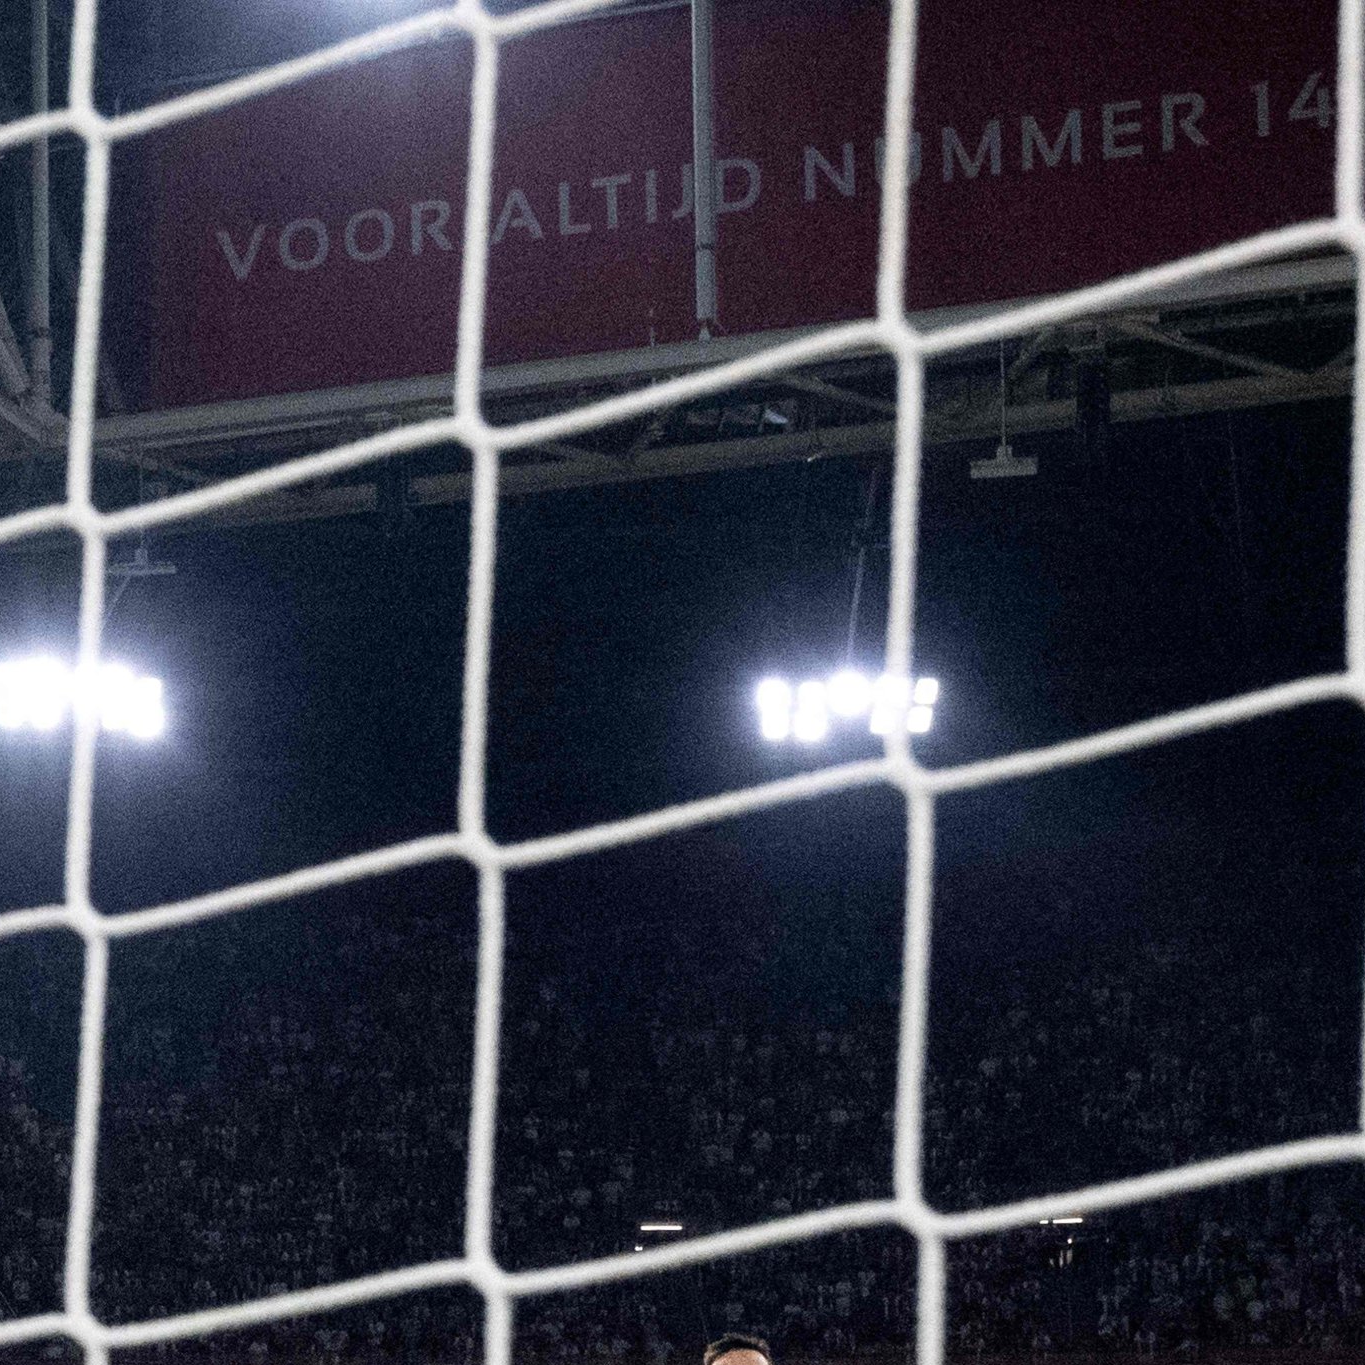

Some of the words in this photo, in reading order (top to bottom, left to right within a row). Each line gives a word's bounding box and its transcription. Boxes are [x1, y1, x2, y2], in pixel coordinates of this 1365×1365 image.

[216, 201, 453, 281] VOOR
[492, 158, 762, 244] ALTIJD
[804, 92, 1210, 202] NUMMER
[1249, 72, 1335, 137] 14
